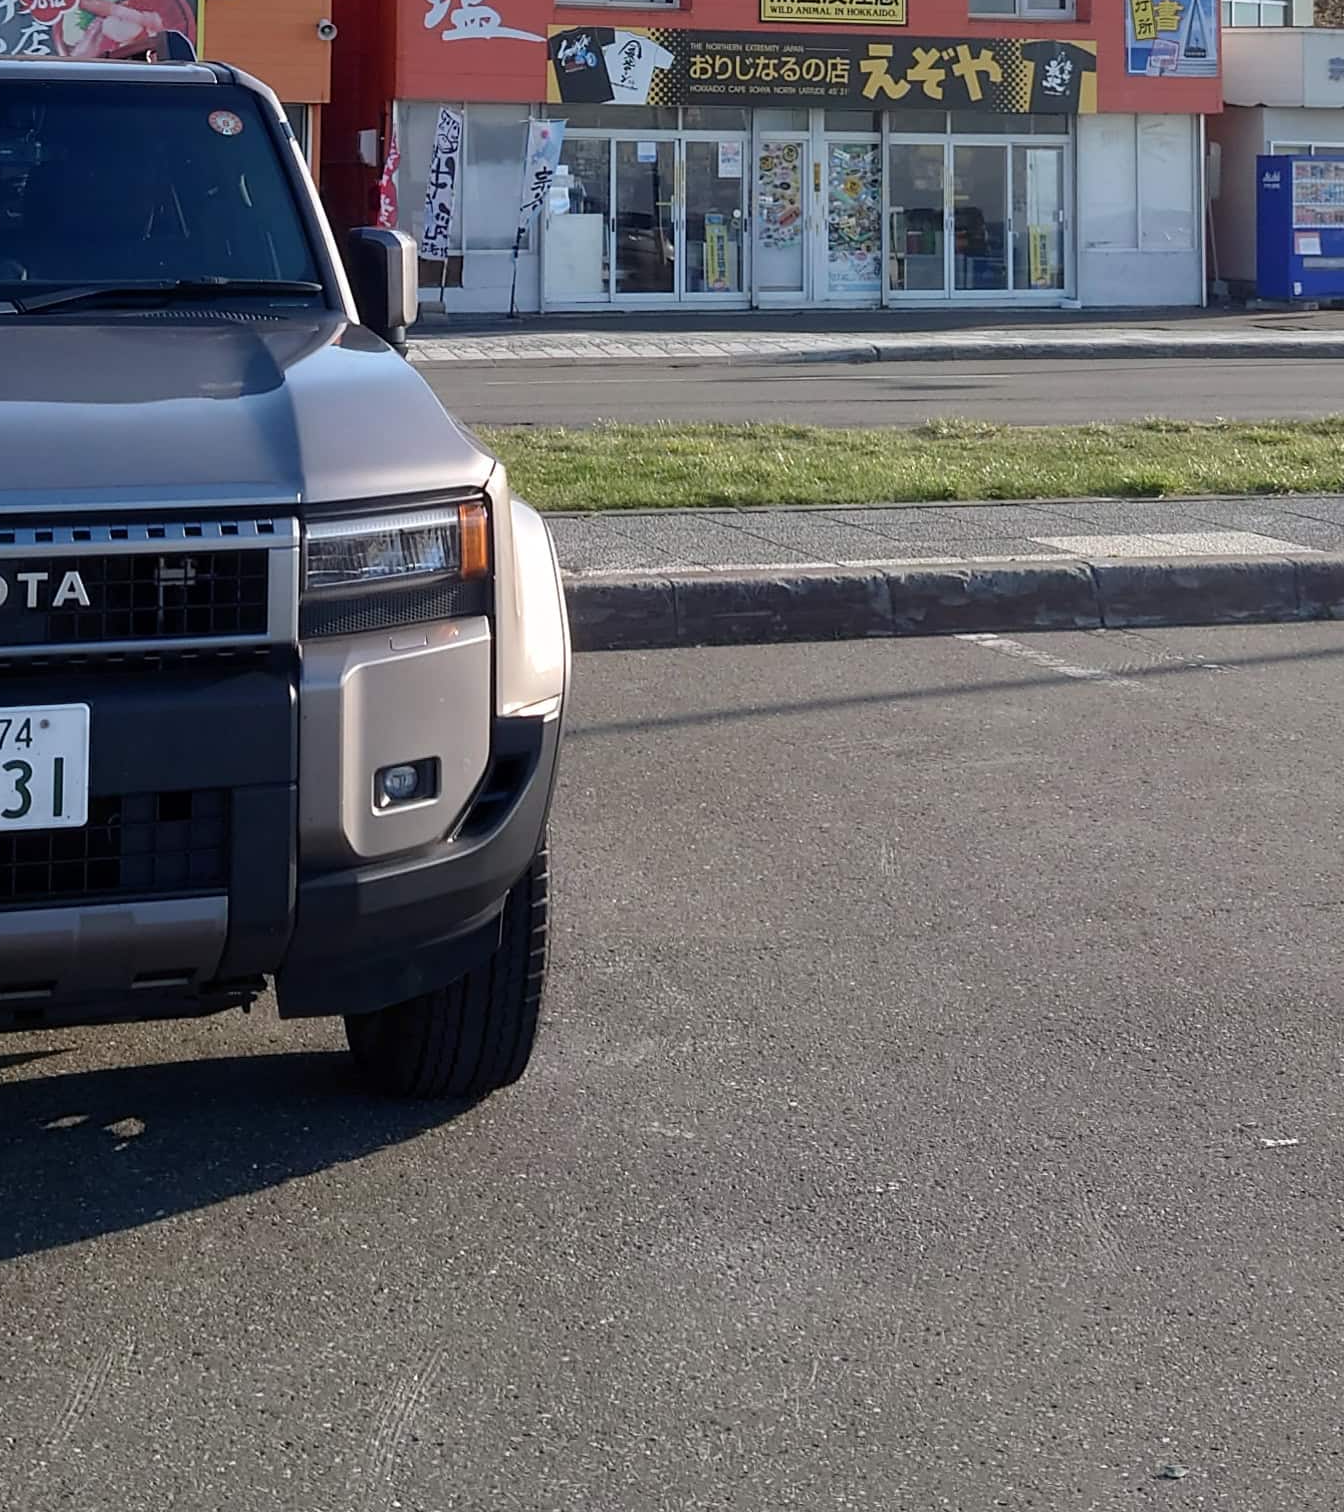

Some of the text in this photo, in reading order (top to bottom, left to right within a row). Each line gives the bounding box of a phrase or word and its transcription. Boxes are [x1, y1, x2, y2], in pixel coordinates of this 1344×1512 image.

[770, 6, 794, 14] WILD
[796, 6, 831, 15] ANIMAL
[834, 7, 844, 15] IN
[689, 54, 851, 84] おりじなるの店
[859, 44, 1003, 101] えぞや
